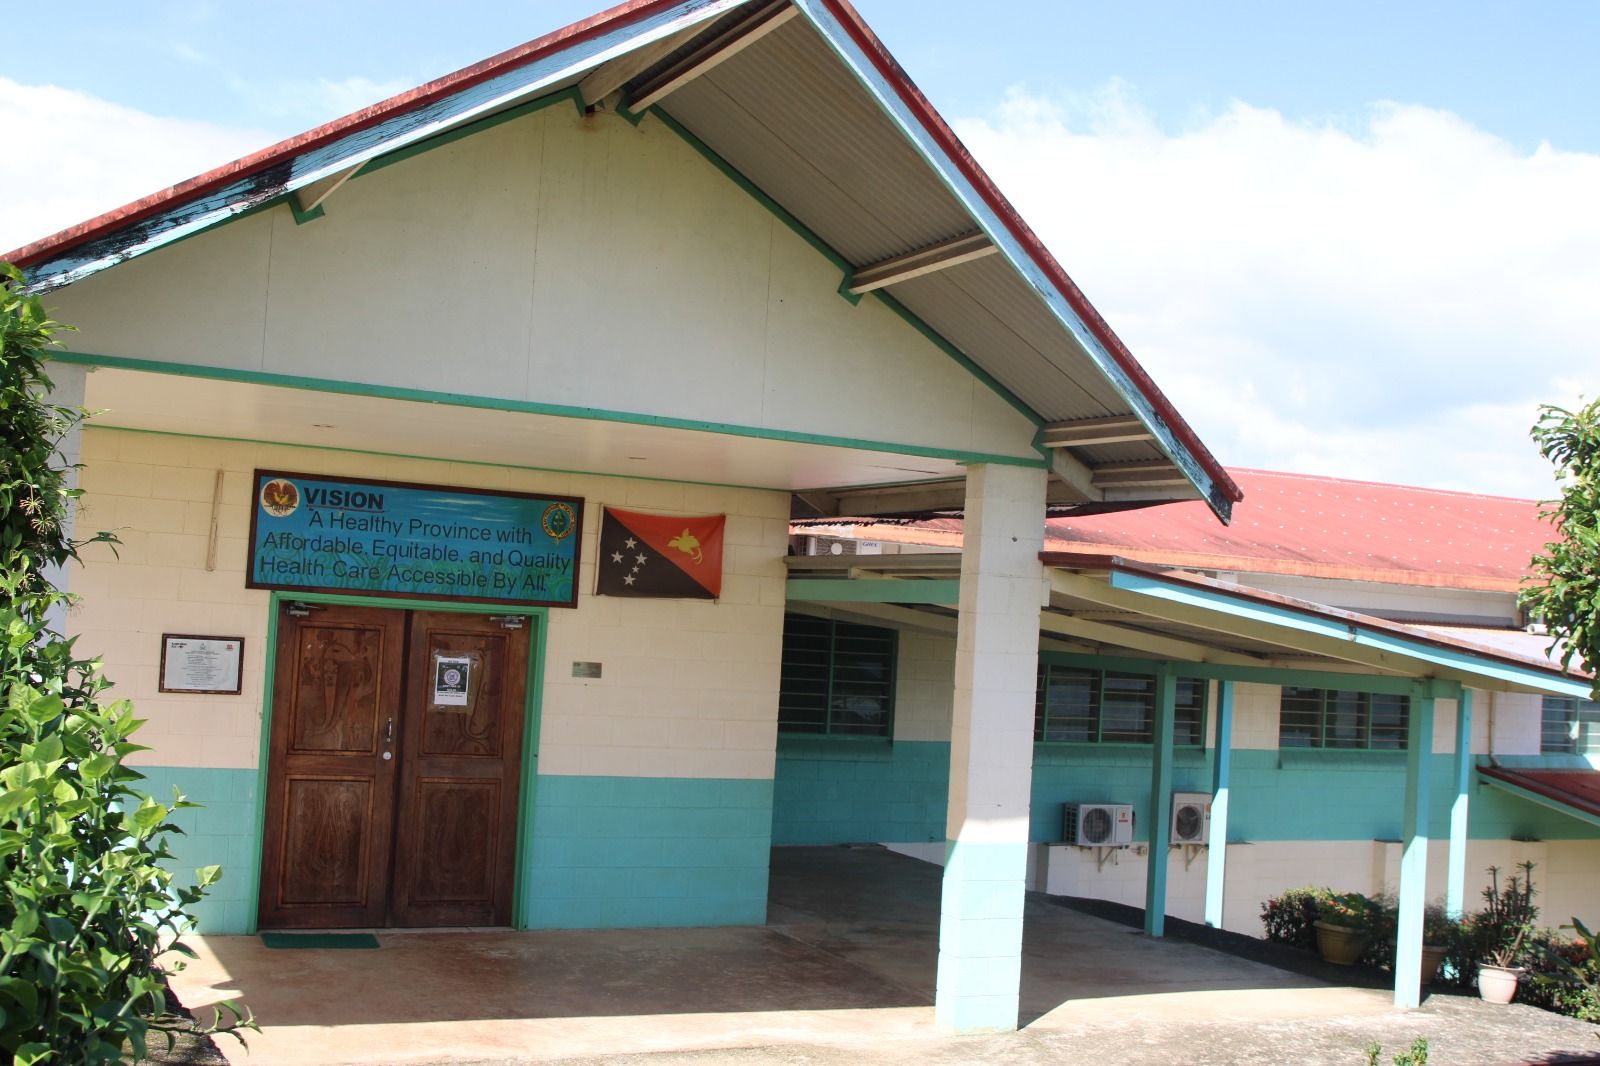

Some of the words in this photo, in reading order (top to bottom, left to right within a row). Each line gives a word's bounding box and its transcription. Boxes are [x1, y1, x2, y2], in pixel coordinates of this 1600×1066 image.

[304, 487, 384, 510] VISION
[331, 511, 403, 538] Healthy
[409, 518, 491, 541] Province
[496, 526, 532, 545] with
[260, 555, 324, 577] Health
[332, 560, 380, 580] Care
[386, 563, 487, 587] Accessible
[493, 572, 517, 594] By
[469, 549, 503, 565] and
[508, 549, 571, 575] Quality
